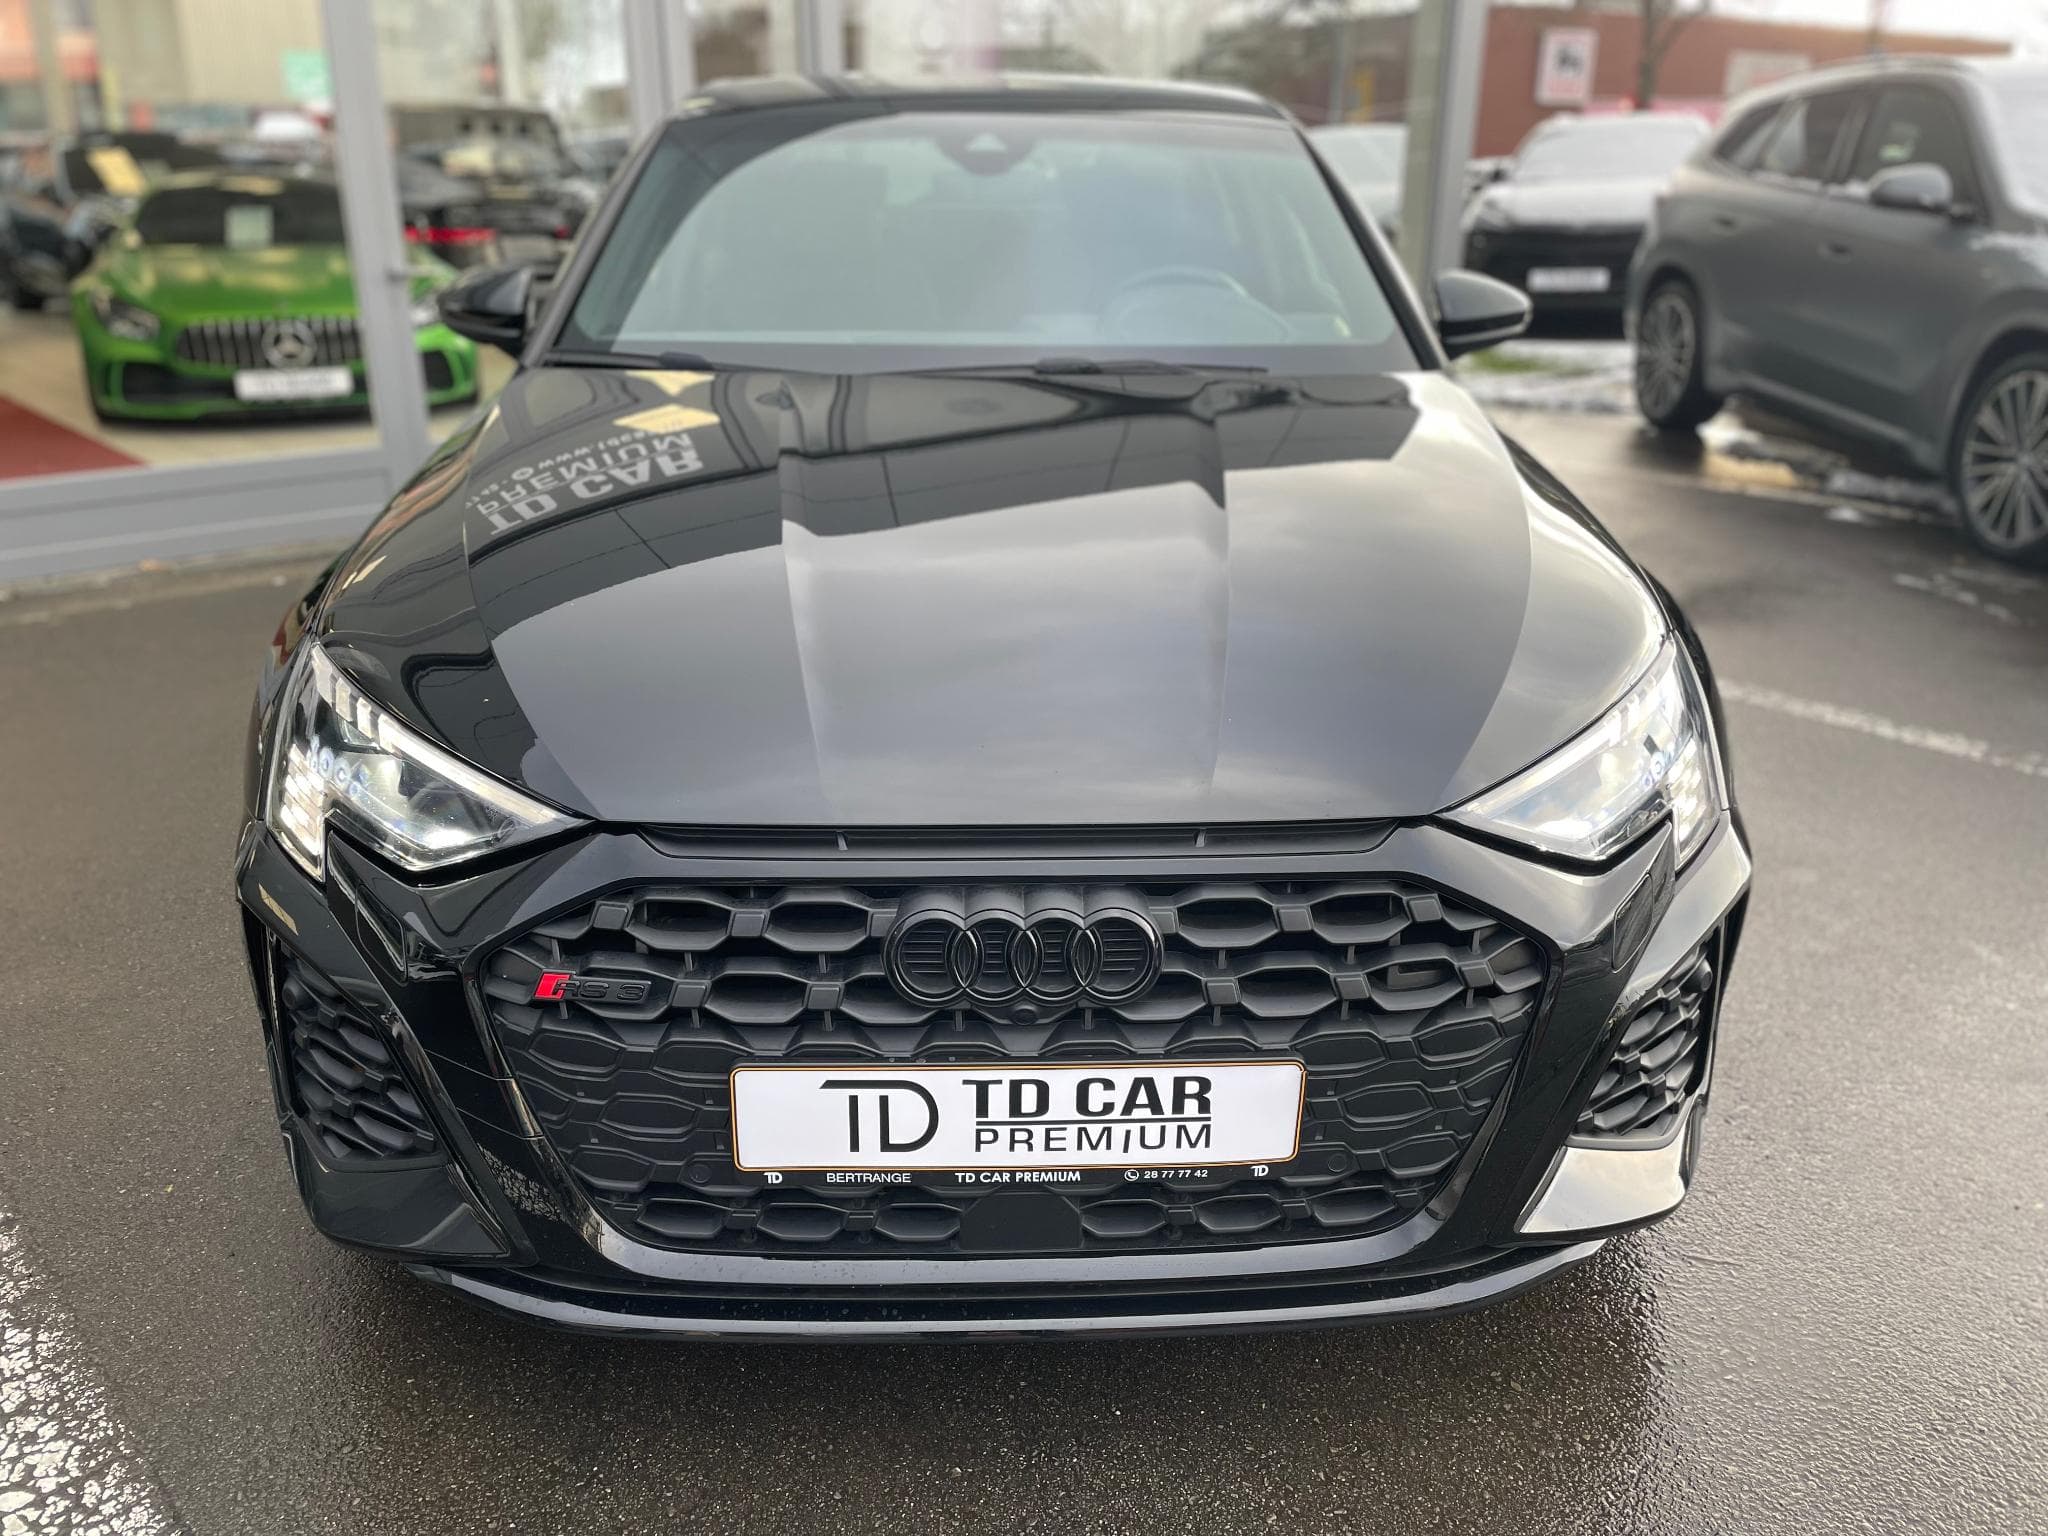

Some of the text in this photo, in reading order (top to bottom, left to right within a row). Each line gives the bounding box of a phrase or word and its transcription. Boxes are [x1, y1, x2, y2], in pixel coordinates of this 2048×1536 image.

[540, 974, 645, 1000] RS 3
[962, 1075, 1212, 1119] TD CAR
[975, 1123, 1212, 1154] PREMIUM
[826, 1172, 912, 1183] BERTRANGE
[955, 1170, 1081, 1183] TD CAR PREMIUM
[1143, 1169, 1208, 1179] 28 77 77 42
